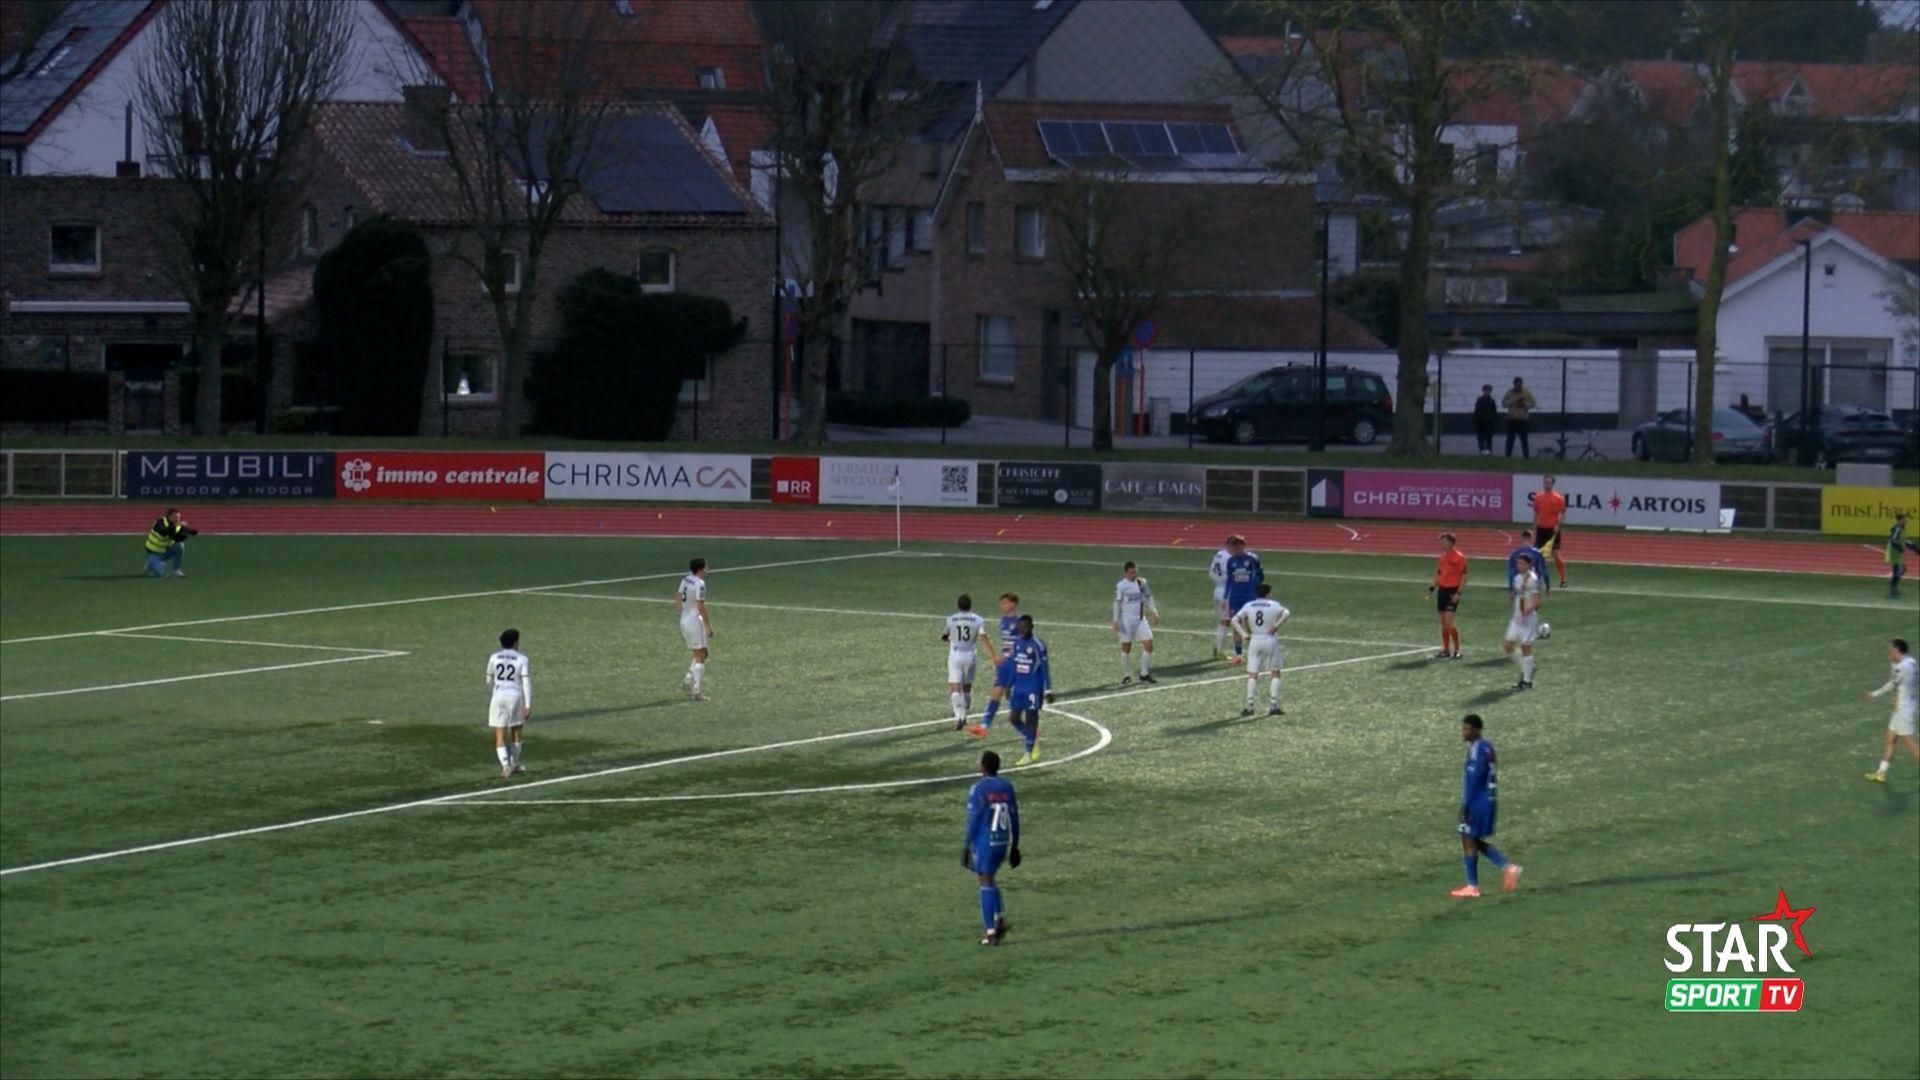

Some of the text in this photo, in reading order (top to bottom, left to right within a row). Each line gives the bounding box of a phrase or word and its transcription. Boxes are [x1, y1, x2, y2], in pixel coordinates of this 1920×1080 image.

[141, 455, 314, 478] MEUBILI
[376, 466, 540, 484] immo centrale
[547, 462, 691, 488] CHRISMA
[140, 486, 313, 495] OUTDOOR & INDOOR
[791, 480, 811, 493] RR
[1158, 480, 1202, 495] PARIS
[1353, 490, 1502, 508] CHRISTIAENS
[1527, 492, 1706, 513] SLLA ARTOIS
[1255, 611, 1264, 627] 8
[956, 626, 971, 642] 13
[496, 663, 516, 681] 22
